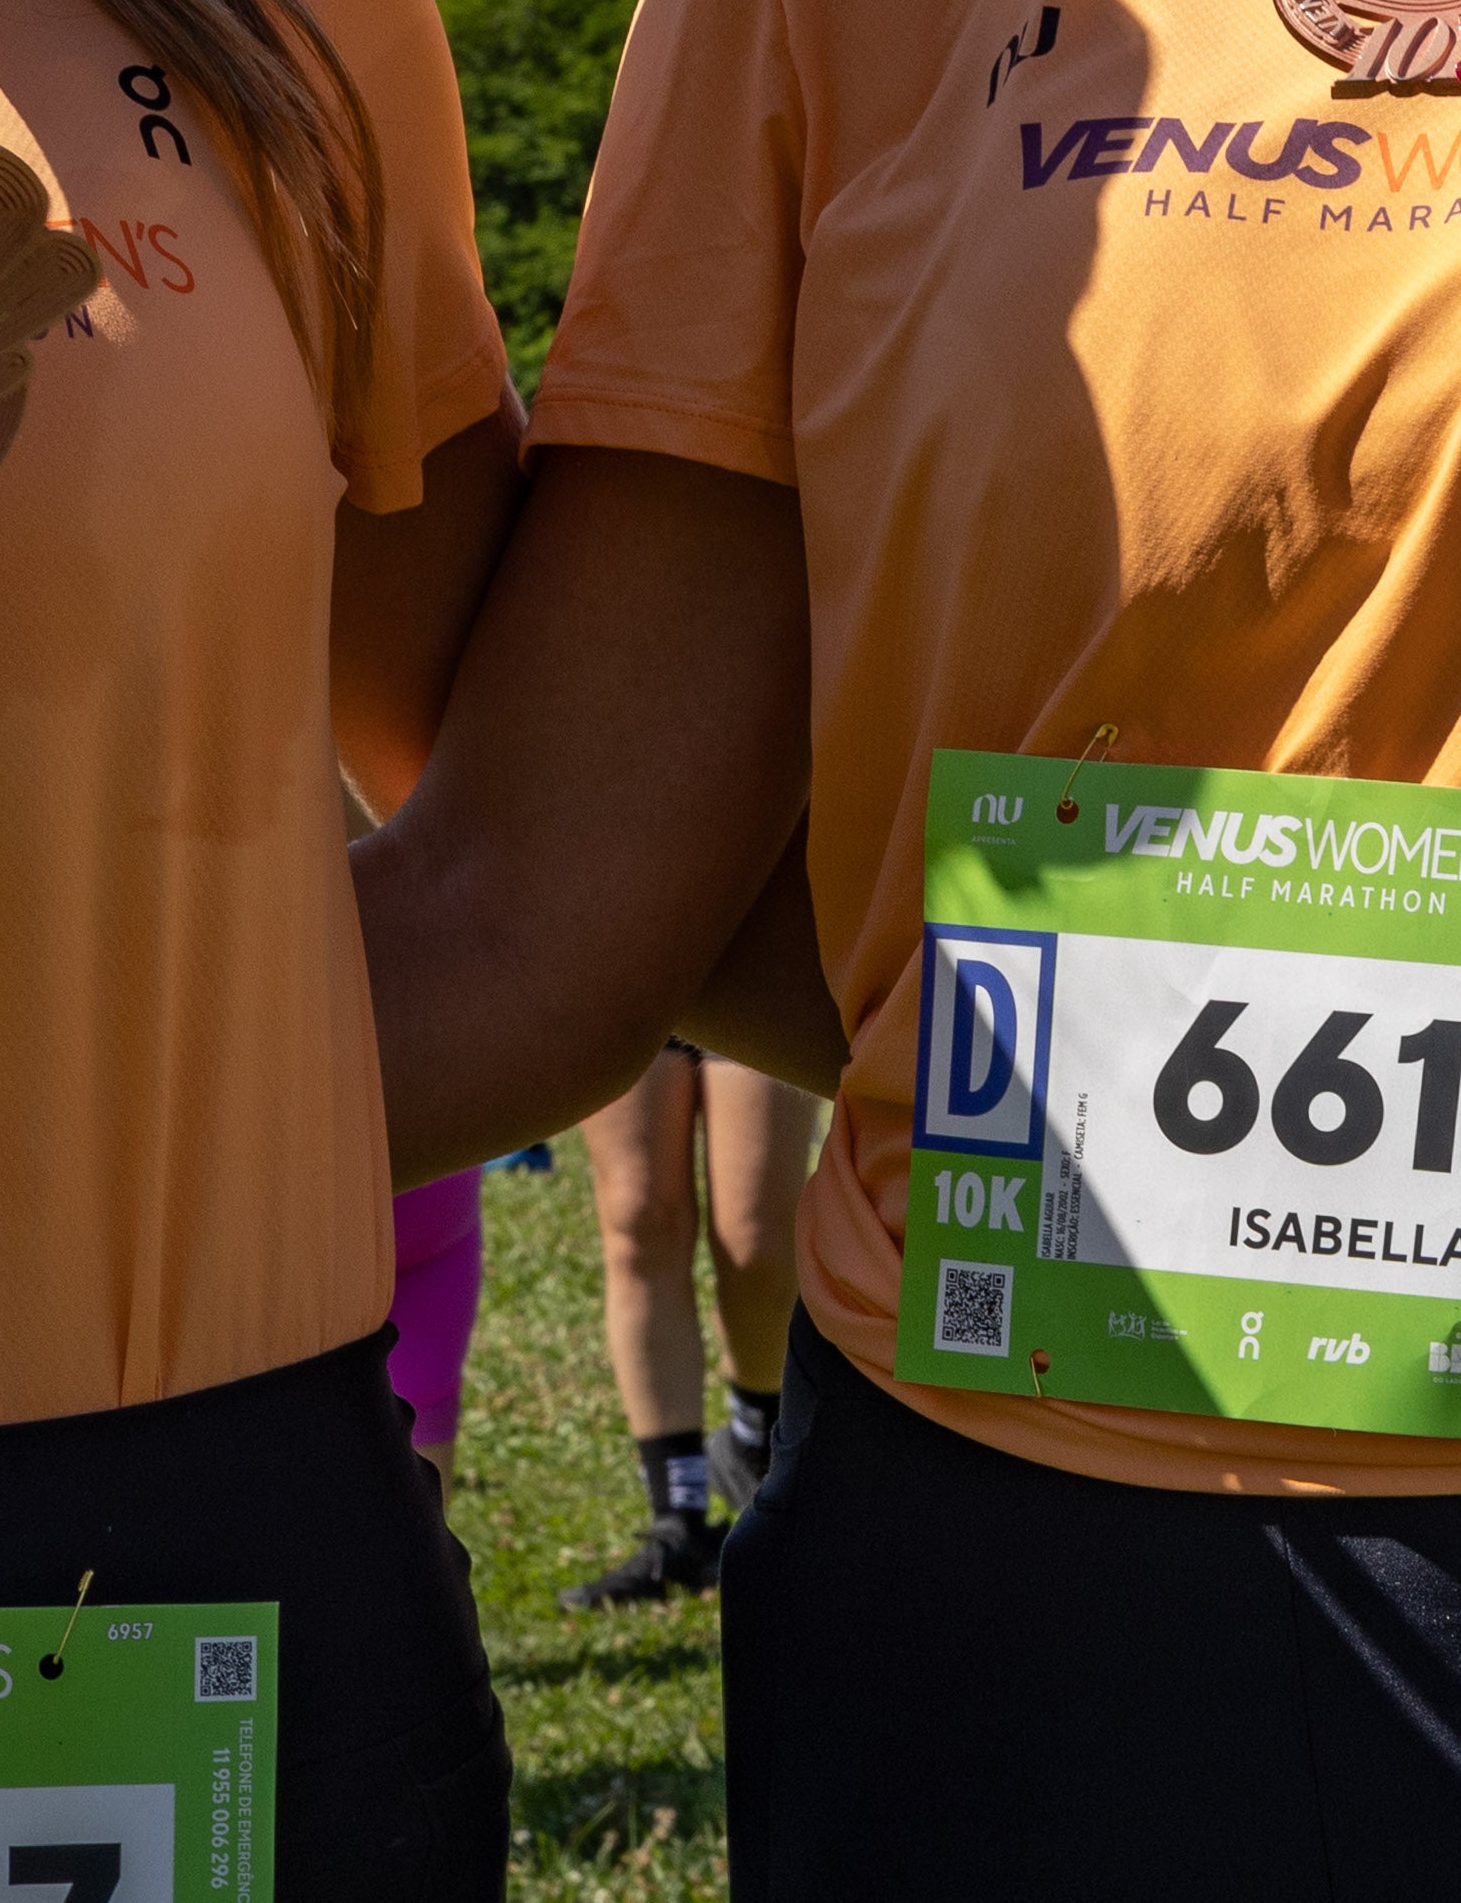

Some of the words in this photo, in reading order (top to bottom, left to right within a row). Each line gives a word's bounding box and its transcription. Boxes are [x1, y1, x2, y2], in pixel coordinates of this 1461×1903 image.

[1018, 116, 1373, 190] VENUS
[1143, 188, 1287, 224] HALF
[1176, 871, 1255, 899] HALF
[1271, 879, 1447, 915] MARATHON
[947, 958, 1019, 1118] D
[934, 1170, 1027, 1233] 10K
[107, 1622, 154, 1642] 6957
[212, 1747, 230, 1764] 11
[238, 1717, 253, 1795] TELEFONE
[211, 1767, 230, 1805] 955
[238, 1796, 252, 1815] DE
[210, 1808, 230, 1849] 006
[209, 1851, 229, 1890] 296
